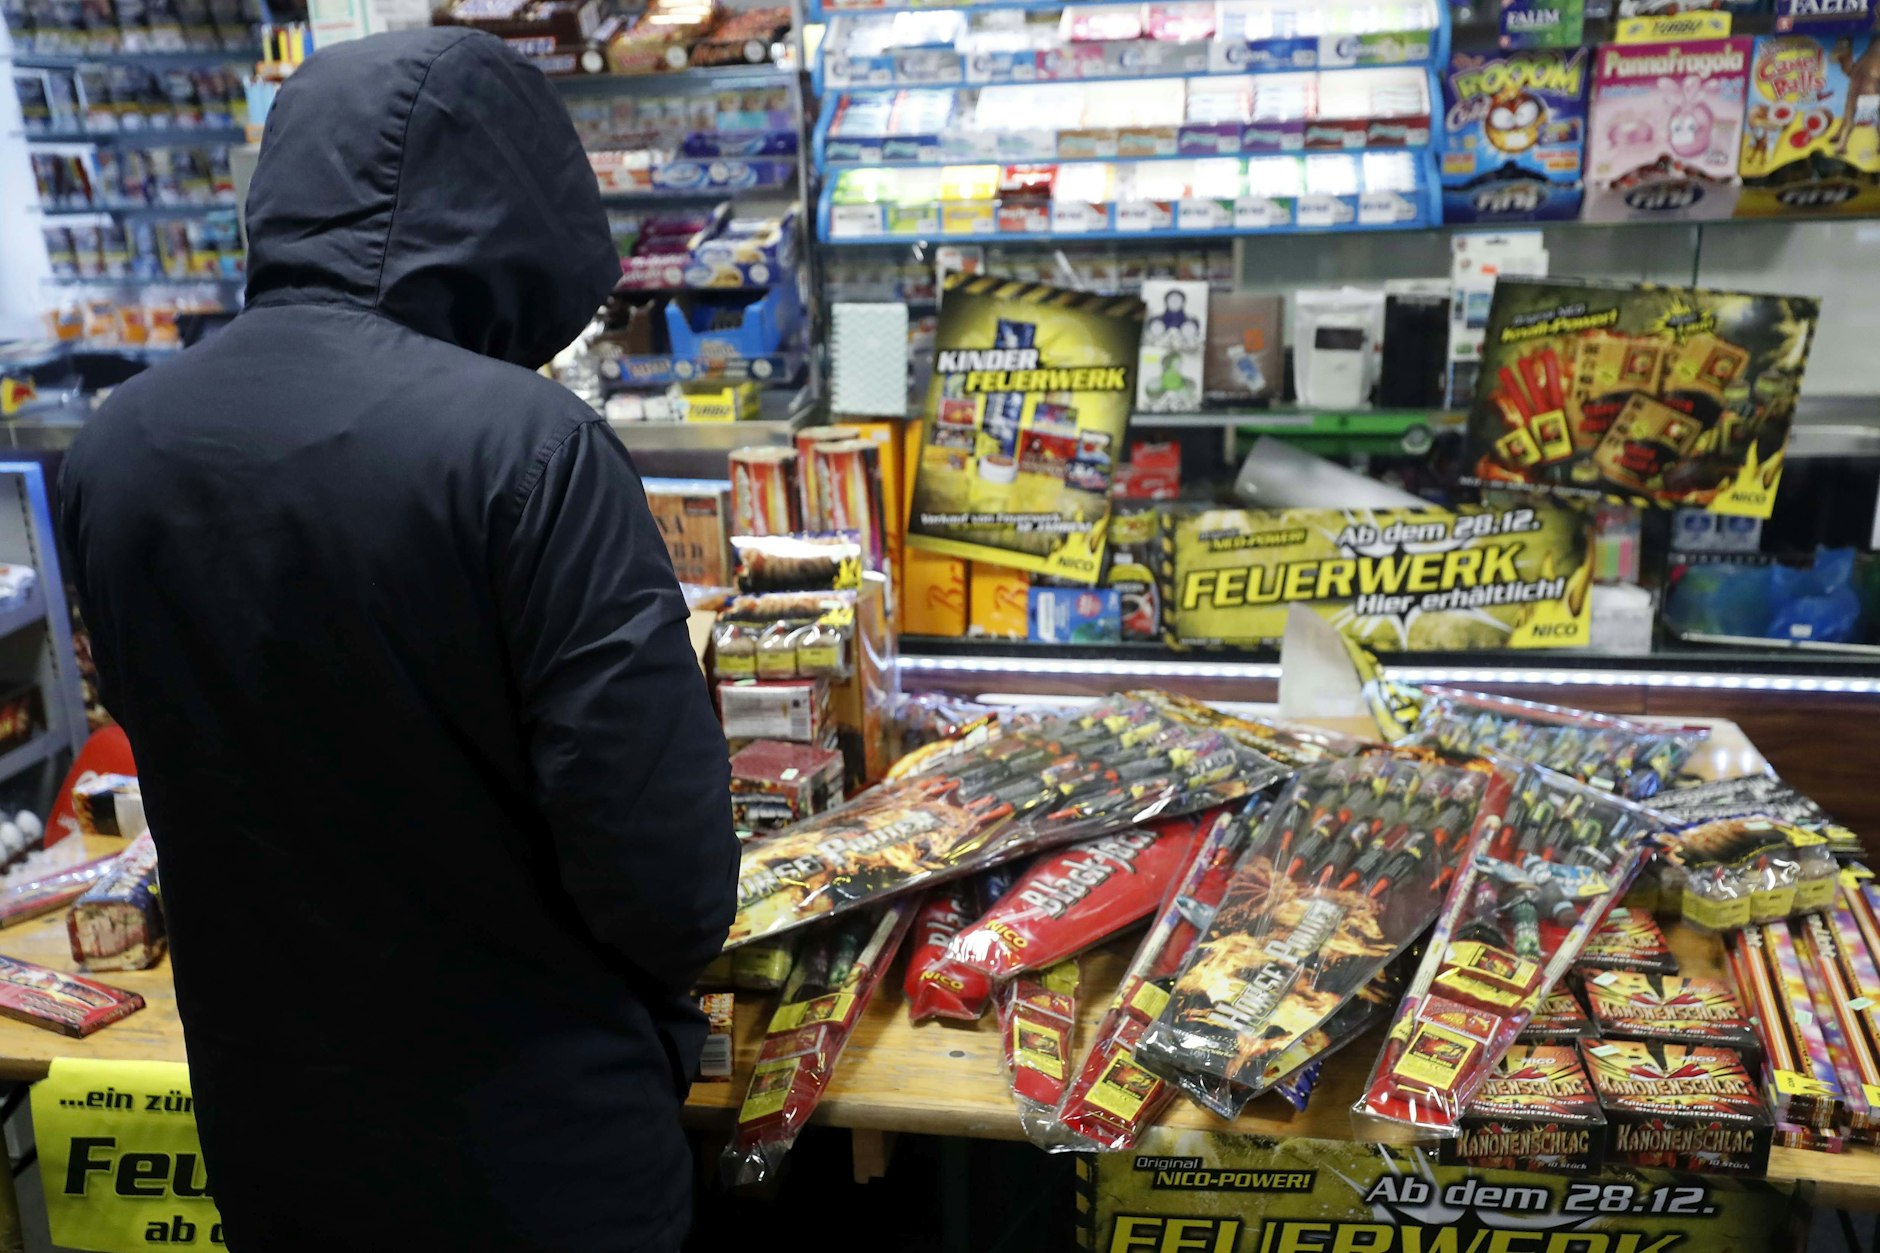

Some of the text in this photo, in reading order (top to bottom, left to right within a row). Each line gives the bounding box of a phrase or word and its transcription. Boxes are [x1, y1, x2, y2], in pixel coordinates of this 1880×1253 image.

[937, 350, 1039, 372] KINDER
[965, 368, 1127, 391] FEUERWERK
[1337, 509, 1542, 547] Ab dem 28.12.
[1058, 557, 1094, 571] NICO
[1182, 543, 1524, 610] FEUERWERK
[1355, 577, 1566, 616] Hier erhältlich!
[1532, 624, 1578, 641] NICO
[984, 918, 1029, 950] NICO
[920, 969, 965, 990] NICO
[1520, 1057, 1557, 1065] NICO
[1600, 1073, 1750, 1097] KANONENSCHLAG
[59, 1087, 134, 1110] ...ein
[1617, 1098, 1691, 1110] Zylindrisch,
[1456, 1129, 1590, 1157] KANONENSCHLAG
[1616, 1123, 1755, 1152] KANONENSCHLAG
[1136, 1156, 1199, 1171] Original
[1560, 1162, 1588, 1170] Stück
[1722, 1160, 1751, 1170] Stück
[1156, 1170, 1312, 1188] NICO-POWER!
[1366, 1175, 1716, 1214] Ab dem 28.12.
[145, 1215, 197, 1243] ab
